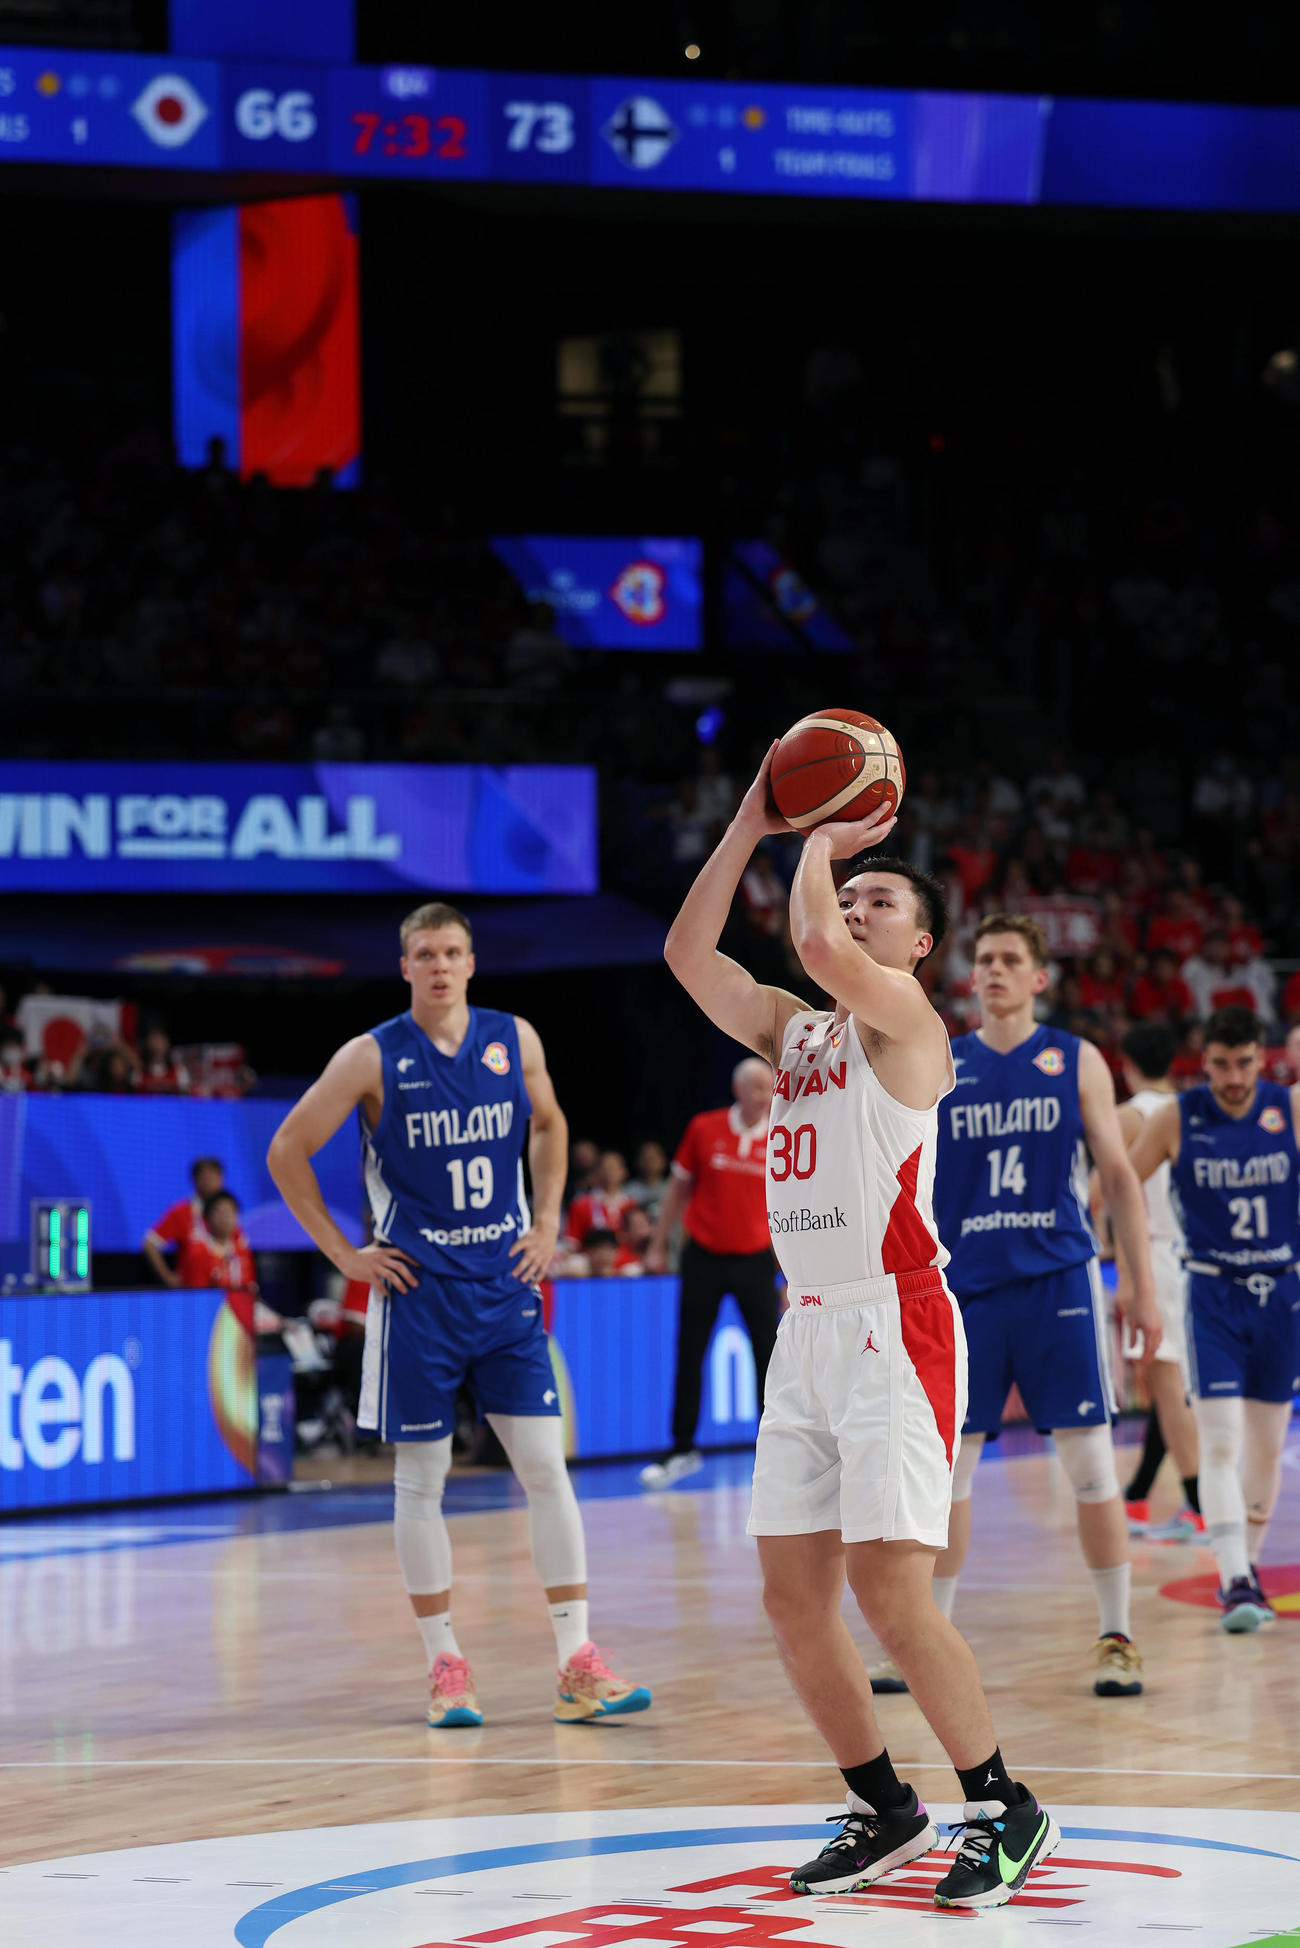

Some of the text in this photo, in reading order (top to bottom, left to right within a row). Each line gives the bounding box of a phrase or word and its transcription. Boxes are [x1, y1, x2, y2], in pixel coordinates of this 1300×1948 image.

[235, 88, 317, 143] 66
[352, 113, 467, 159] 7:32
[503, 101, 575, 153] 73
[118, 795, 228, 836] FOR
[232, 794, 399, 859] ALL
[773, 1061, 847, 1102] AAN
[405, 1101, 514, 1148] FINLAND
[950, 1096, 1061, 1140] FINLAND
[770, 1123, 817, 1182] 30
[987, 1145, 1027, 1198] 14
[1193, 1151, 1290, 1188] FINLAND
[446, 1156, 494, 1211] 19
[773, 1206, 848, 1234] SoftBank
[961, 1209, 1056, 1238] postnord
[1228, 1195, 1269, 1240] 21
[800, 1295, 822, 1307] JPN
